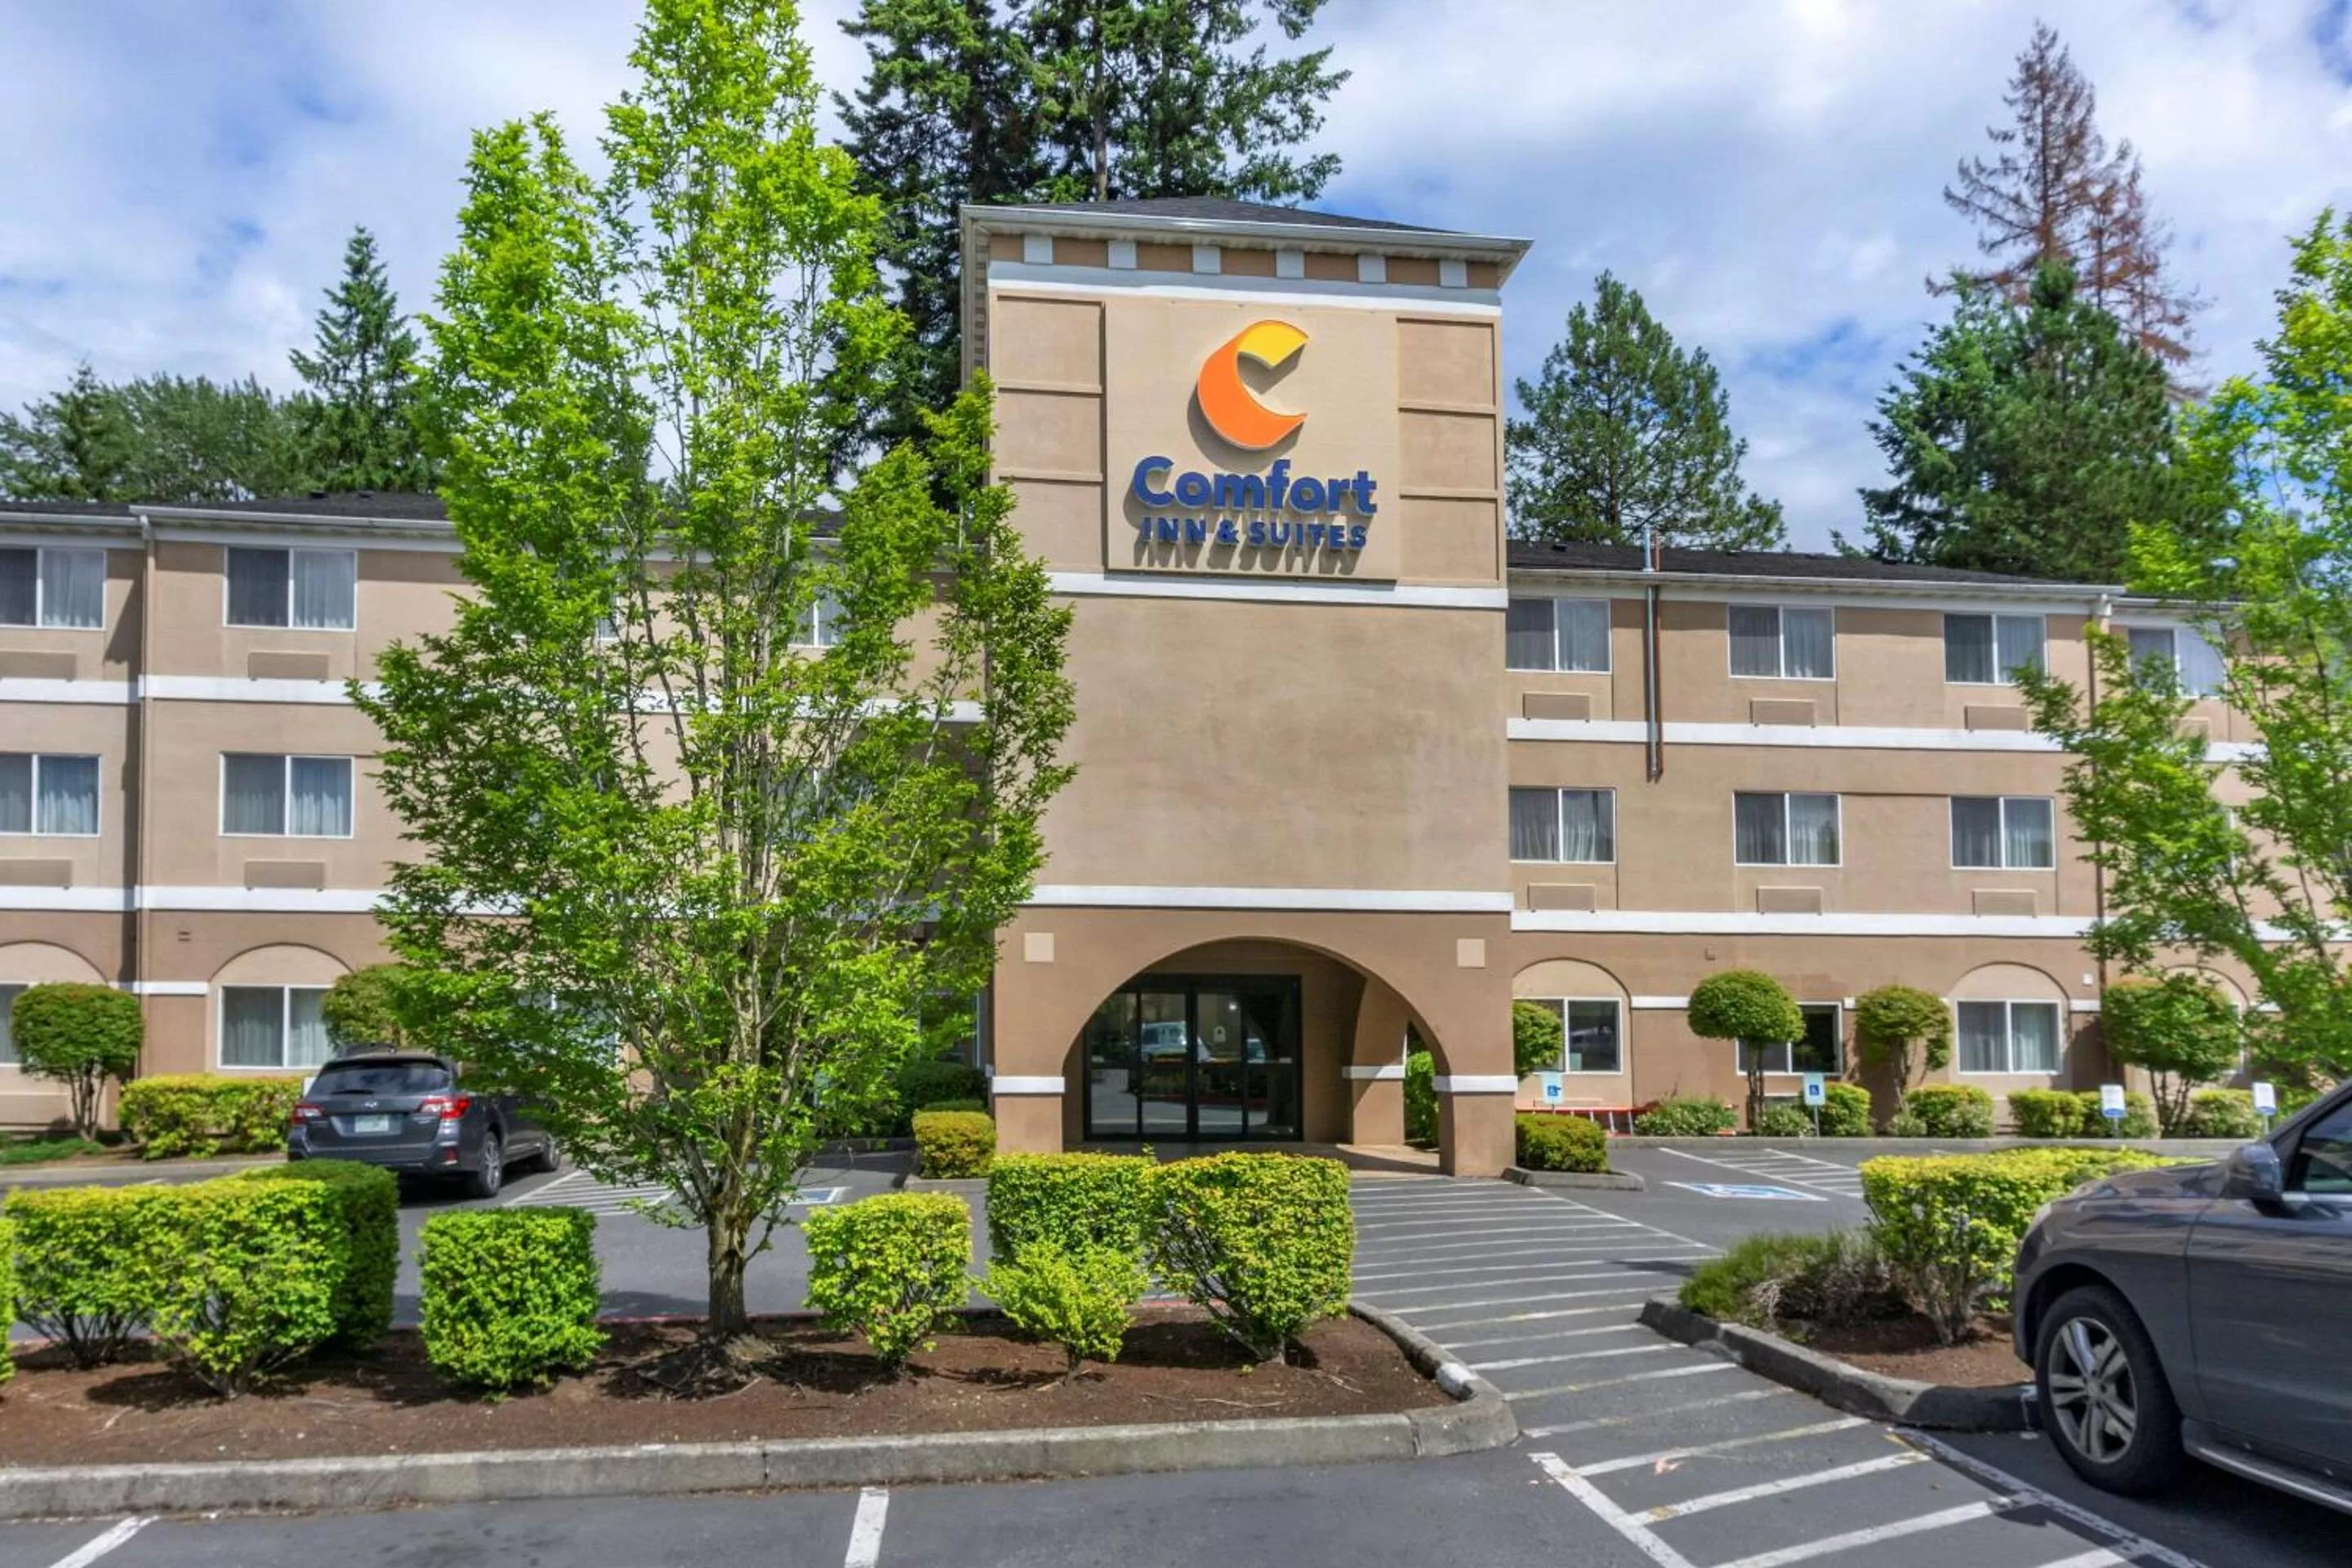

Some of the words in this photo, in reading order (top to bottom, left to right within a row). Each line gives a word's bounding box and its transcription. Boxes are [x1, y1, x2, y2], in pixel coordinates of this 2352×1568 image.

[1133, 456, 1378, 514] Comfort
[1143, 516, 1207, 543] INN
[1218, 520, 1240, 546] &
[1249, 523, 1367, 551] SUITES
